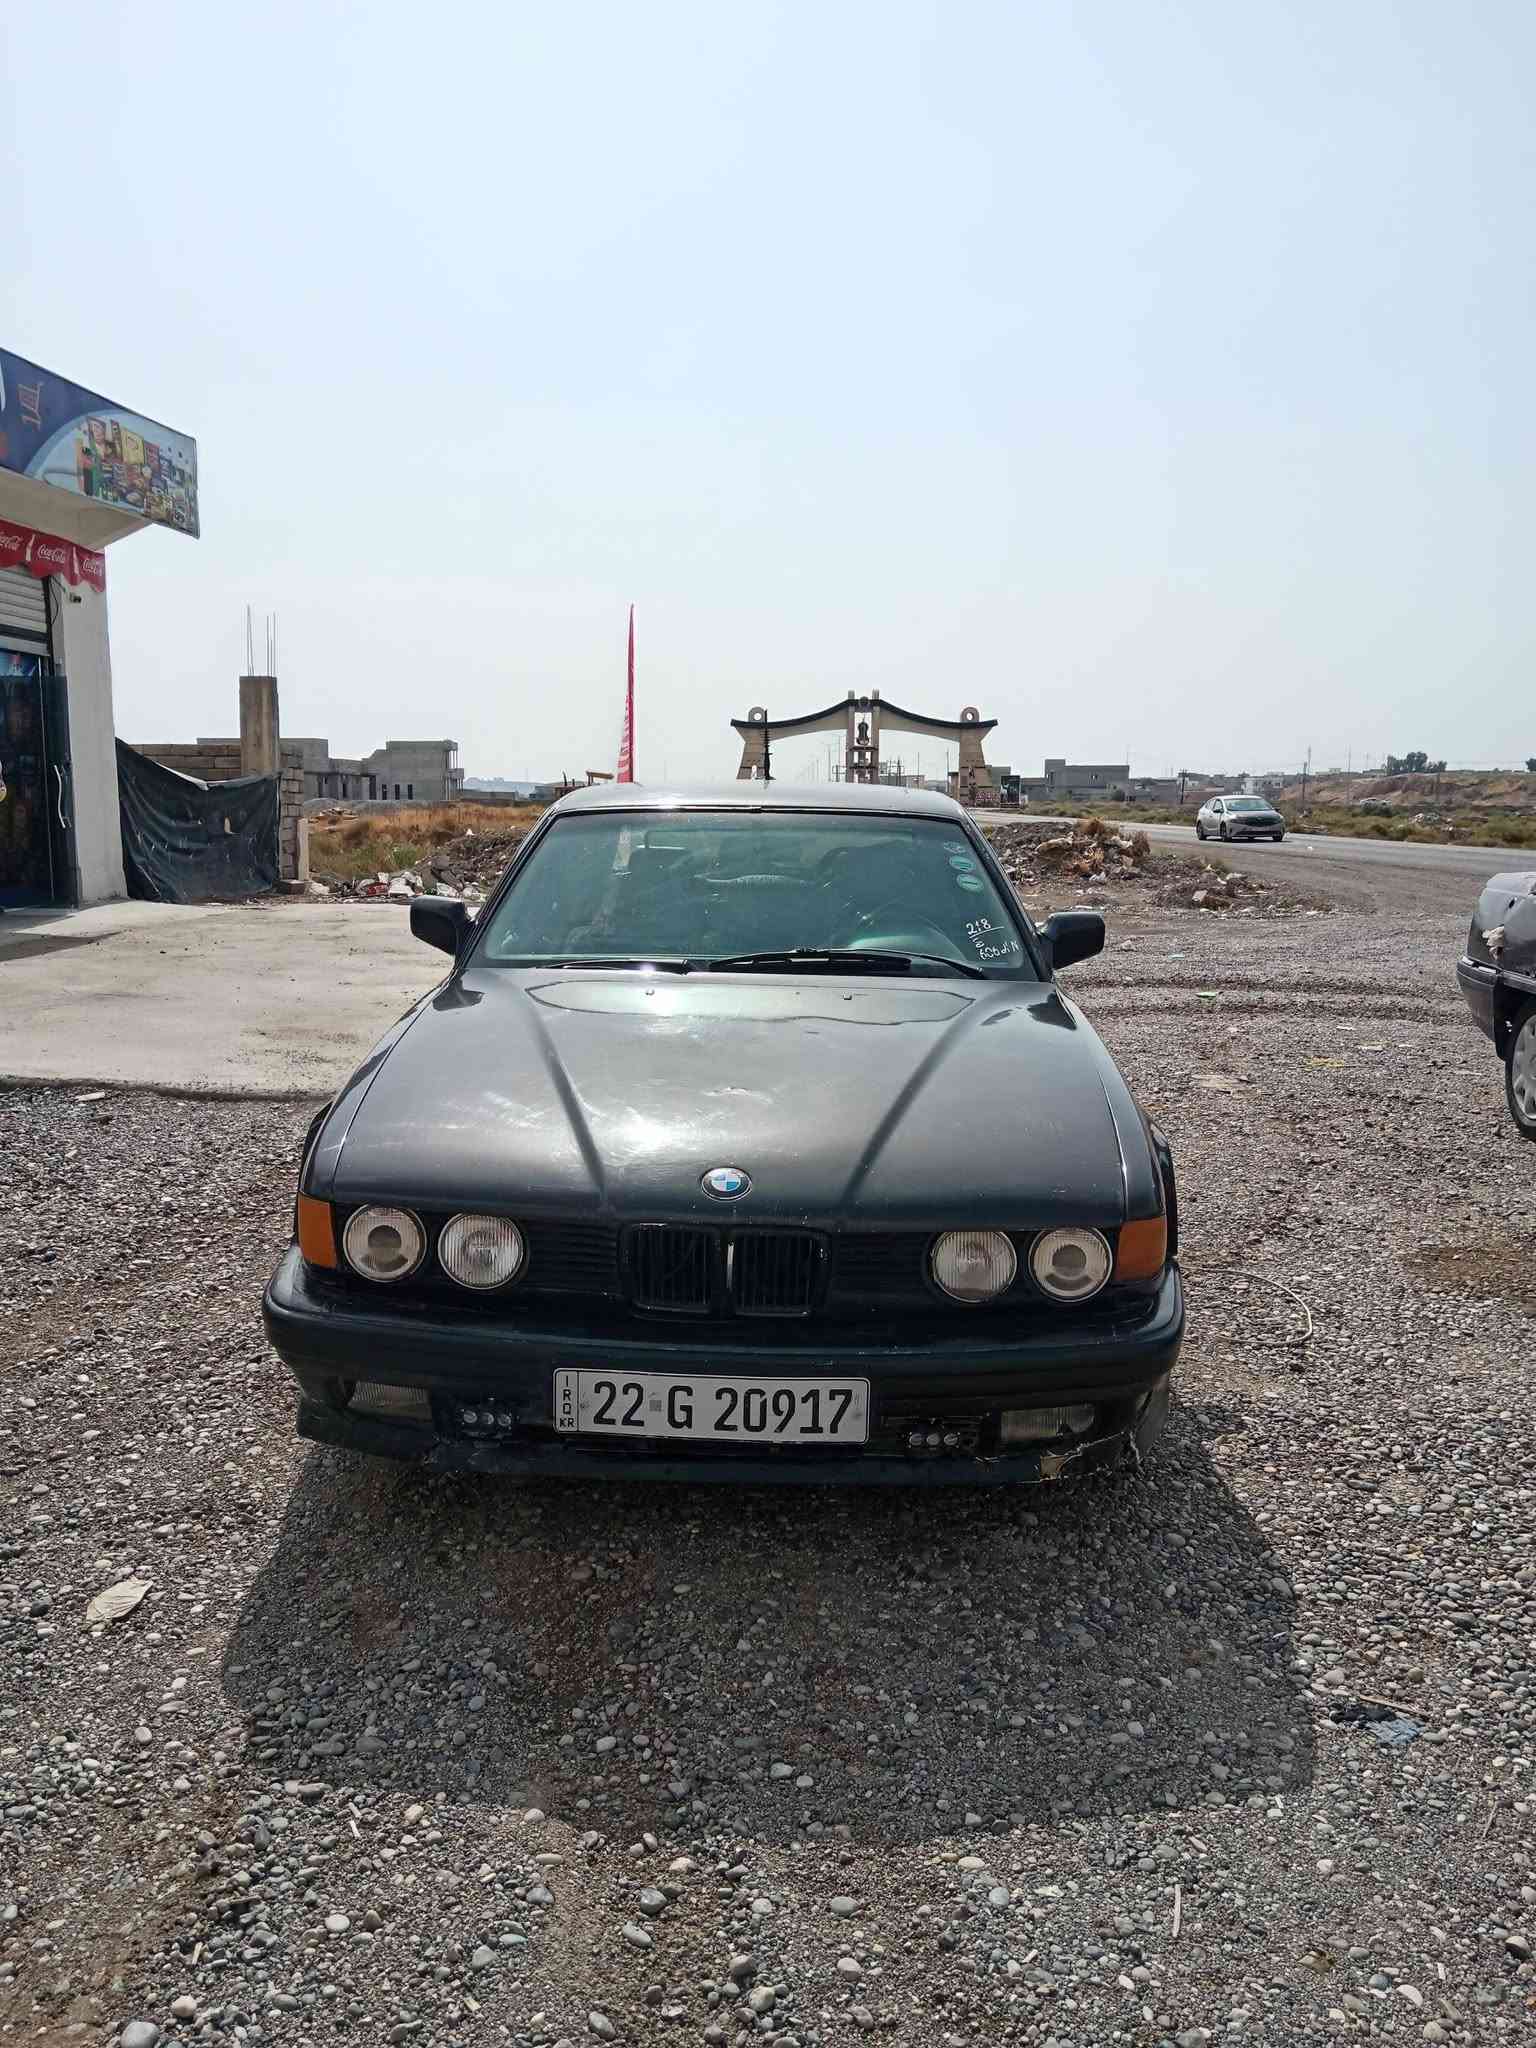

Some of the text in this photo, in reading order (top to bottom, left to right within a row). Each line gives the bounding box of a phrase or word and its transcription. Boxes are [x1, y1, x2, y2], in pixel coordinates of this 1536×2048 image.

[559, 1417, 575, 1428] KR
[593, 1380, 853, 1434] 22 G 20917
